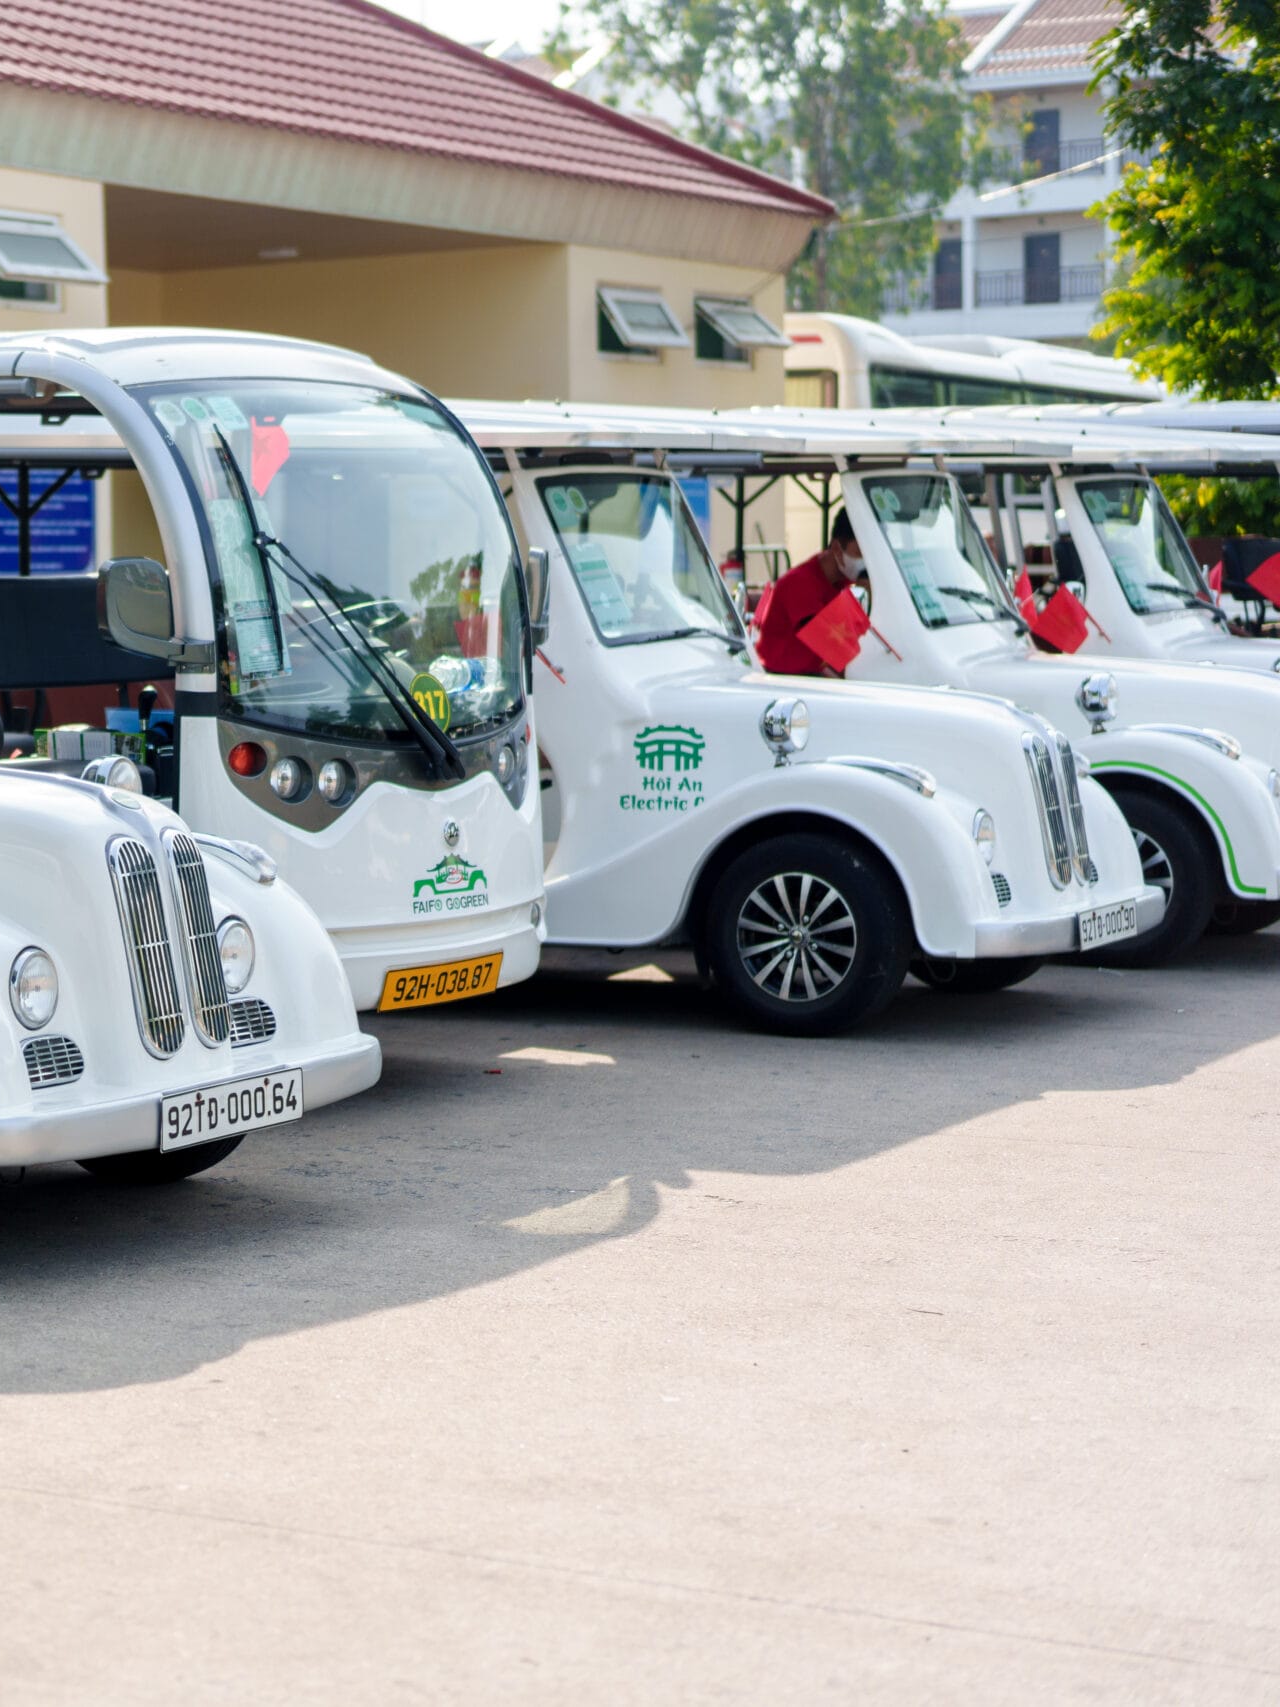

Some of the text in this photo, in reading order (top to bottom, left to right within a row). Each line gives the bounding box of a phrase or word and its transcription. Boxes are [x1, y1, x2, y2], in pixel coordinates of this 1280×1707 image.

[678, 776, 703, 792] An
[619, 794, 688, 812] Electric
[393, 962, 493, 1003] 92H-038.87
